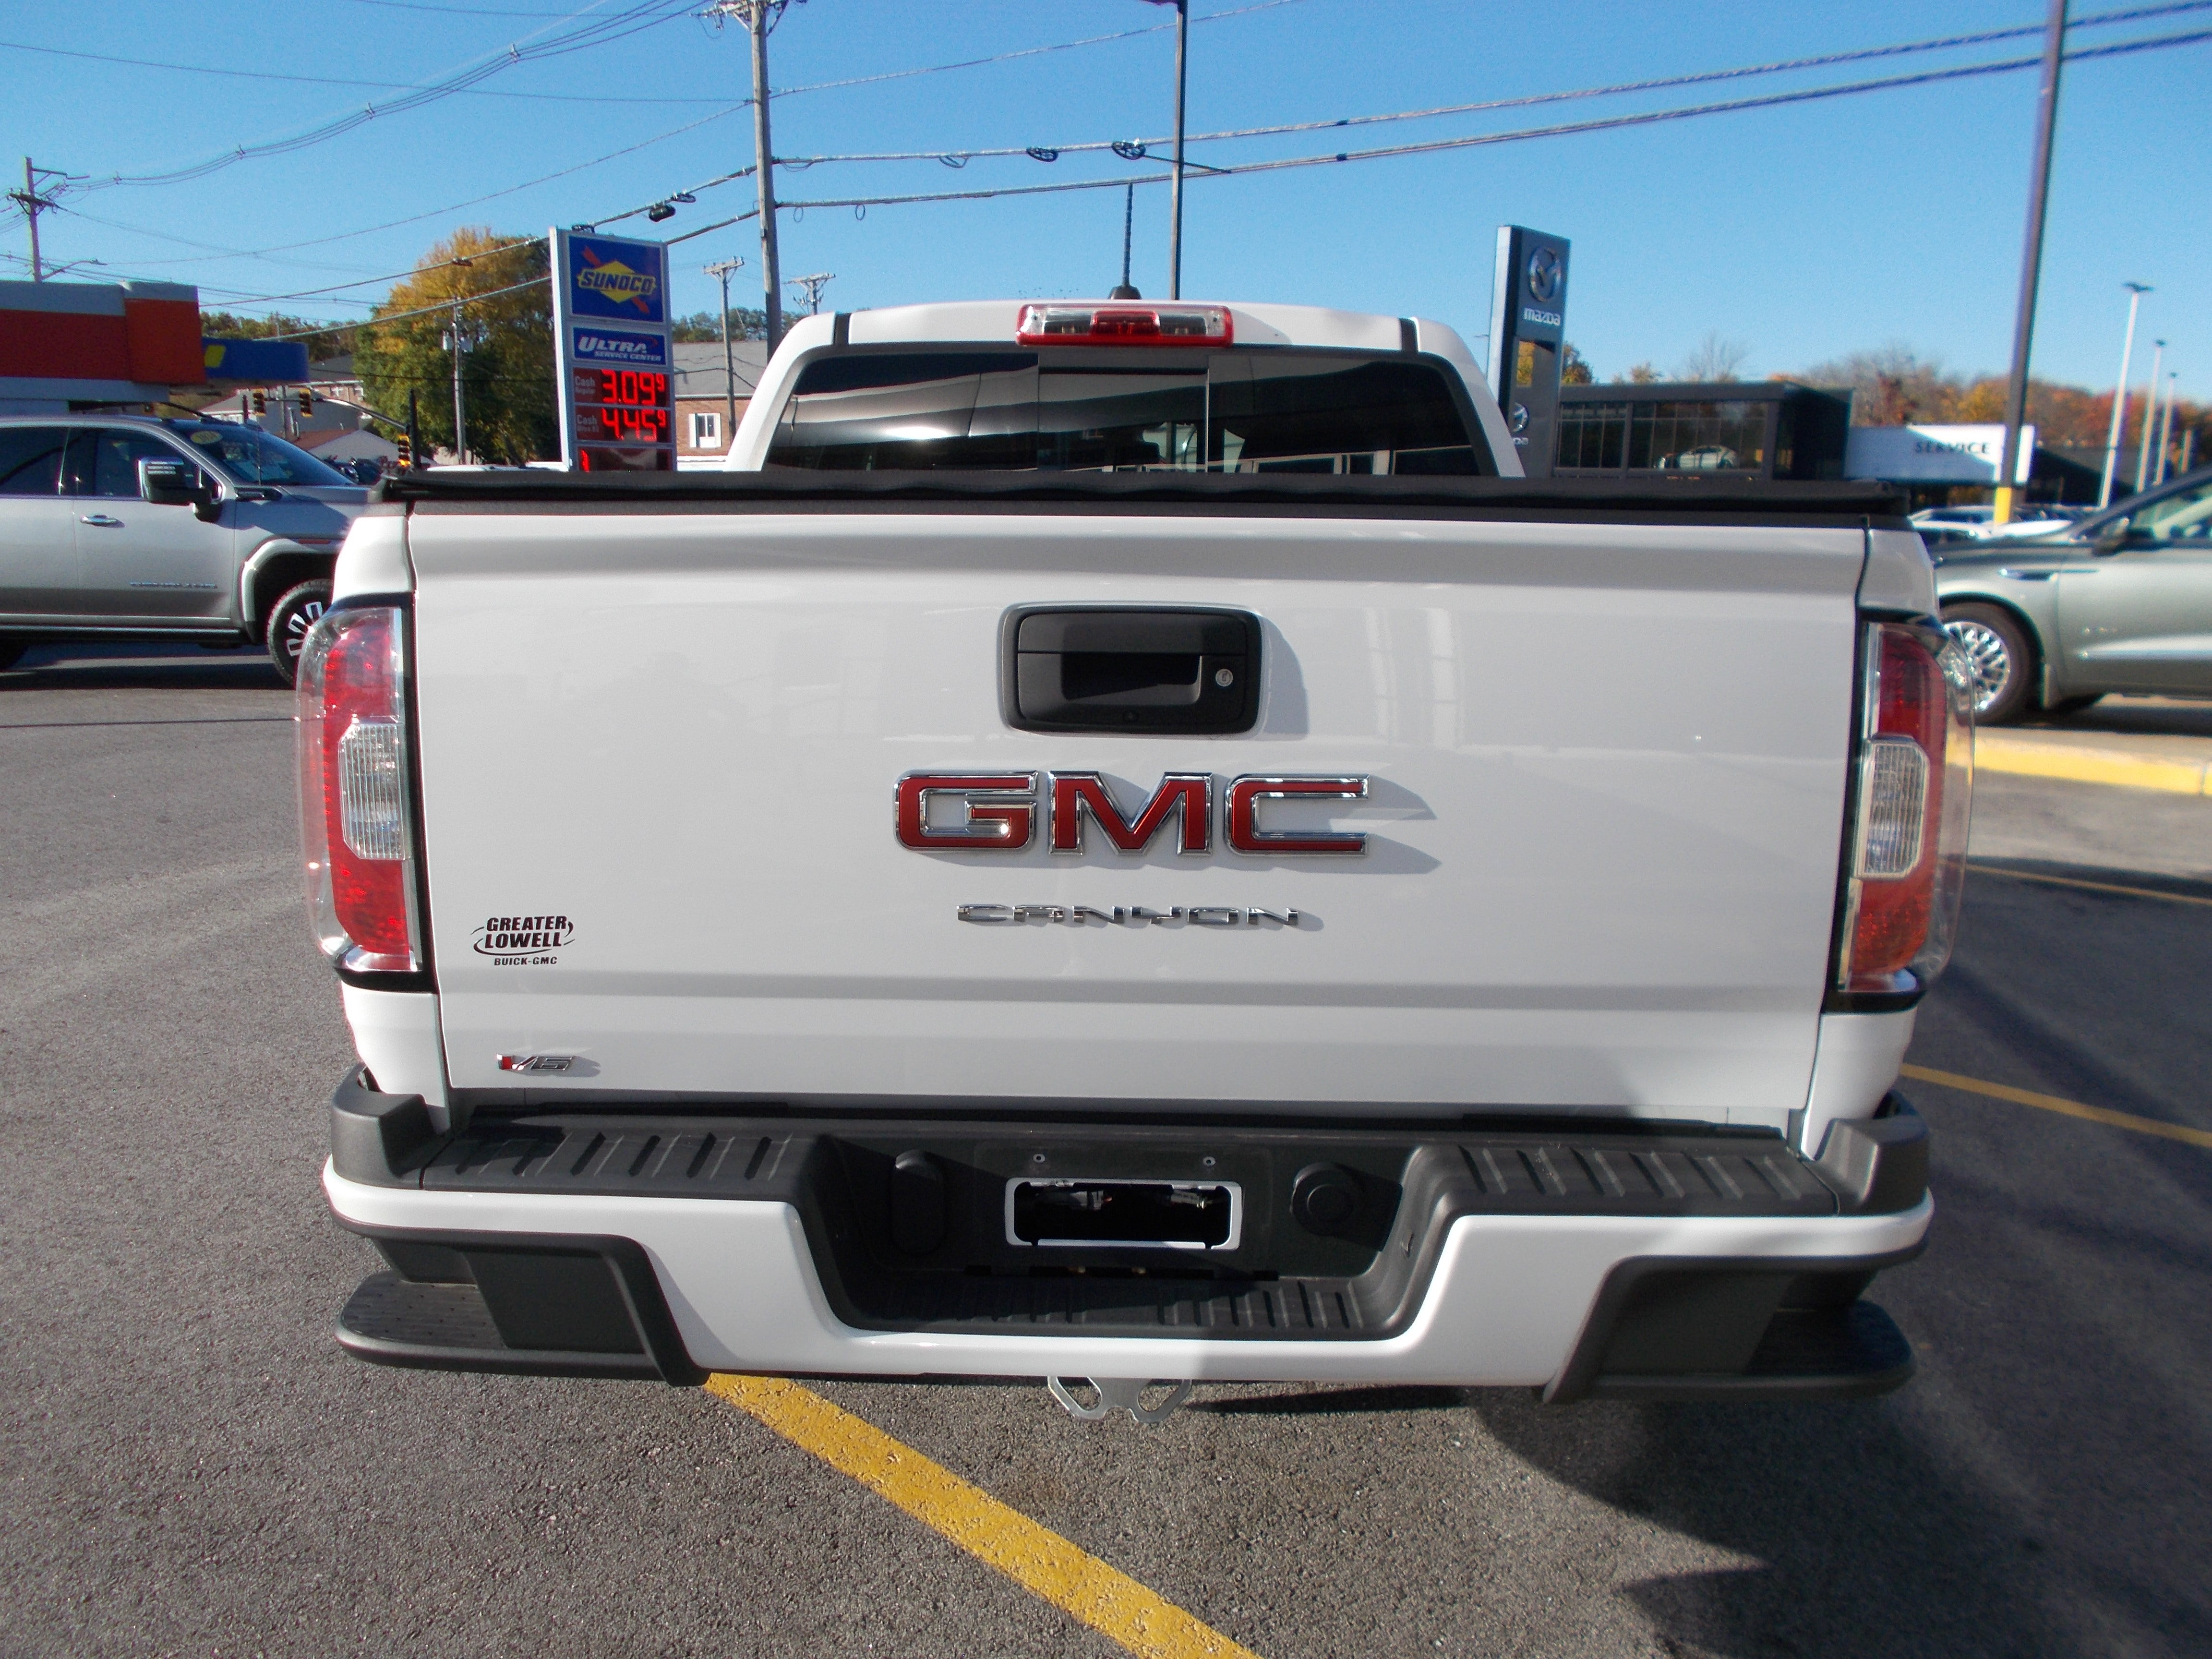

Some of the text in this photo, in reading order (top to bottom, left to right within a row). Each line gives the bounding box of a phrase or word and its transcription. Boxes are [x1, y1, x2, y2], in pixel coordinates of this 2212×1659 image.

[580, 271, 654, 293] SUNOCO
[629, 354, 662, 362] CENTER
[575, 376, 596, 387] Cash
[577, 414, 598, 425] Cash
[1915, 441, 1991, 454] SERVICE
[894, 770, 1370, 856] GMC
[957, 904, 1299, 925] CANYON
[486, 915, 568, 931] GREATER
[484, 932, 562, 949] LOWELL
[494, 956, 558, 966] BUICK-GMC
[496, 1054, 573, 1071] V6
